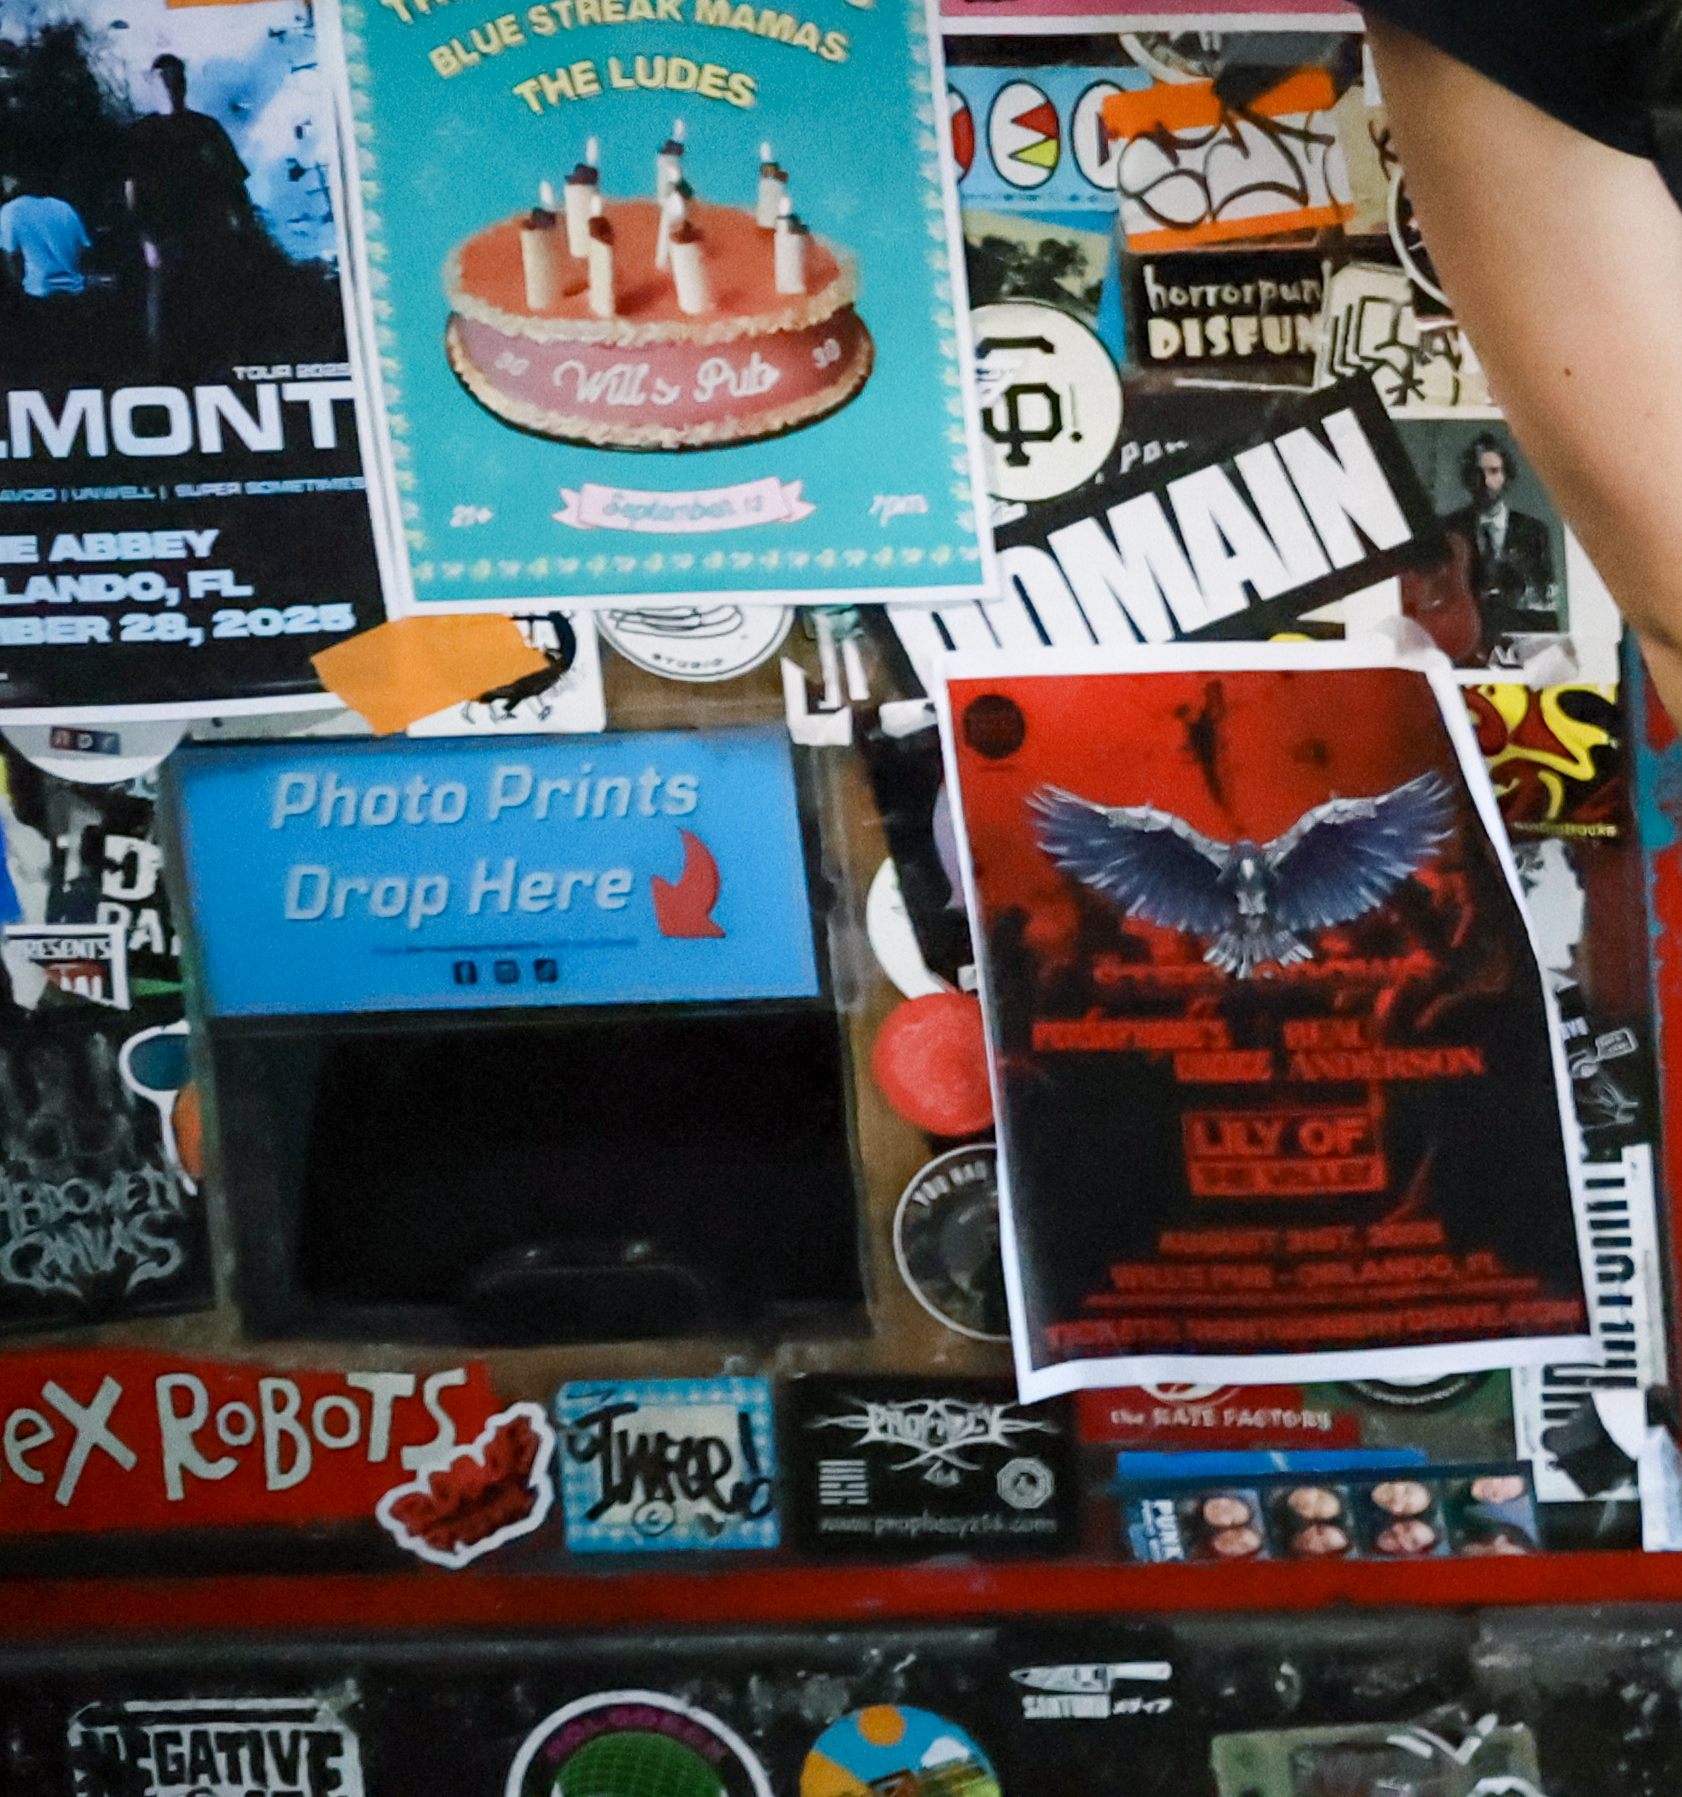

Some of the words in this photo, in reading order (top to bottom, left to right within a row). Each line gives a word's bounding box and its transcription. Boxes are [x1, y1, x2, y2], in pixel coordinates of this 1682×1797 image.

[427, 12, 526, 80] BLUE
[511, 59, 603, 116] THE
[606, 54, 759, 110] LUDES
[232, 364, 292, 381] TOUR
[0, 380, 356, 460] MONT
[49, 528, 221, 562] ABBEY
[187, 568, 255, 600] FL
[118, 611, 205, 647] 28,
[211, 603, 358, 640] 2025
[269, 770, 468, 830] Photo
[486, 761, 701, 821] Prints
[283, 862, 450, 930] Drop
[466, 856, 635, 915] Here
